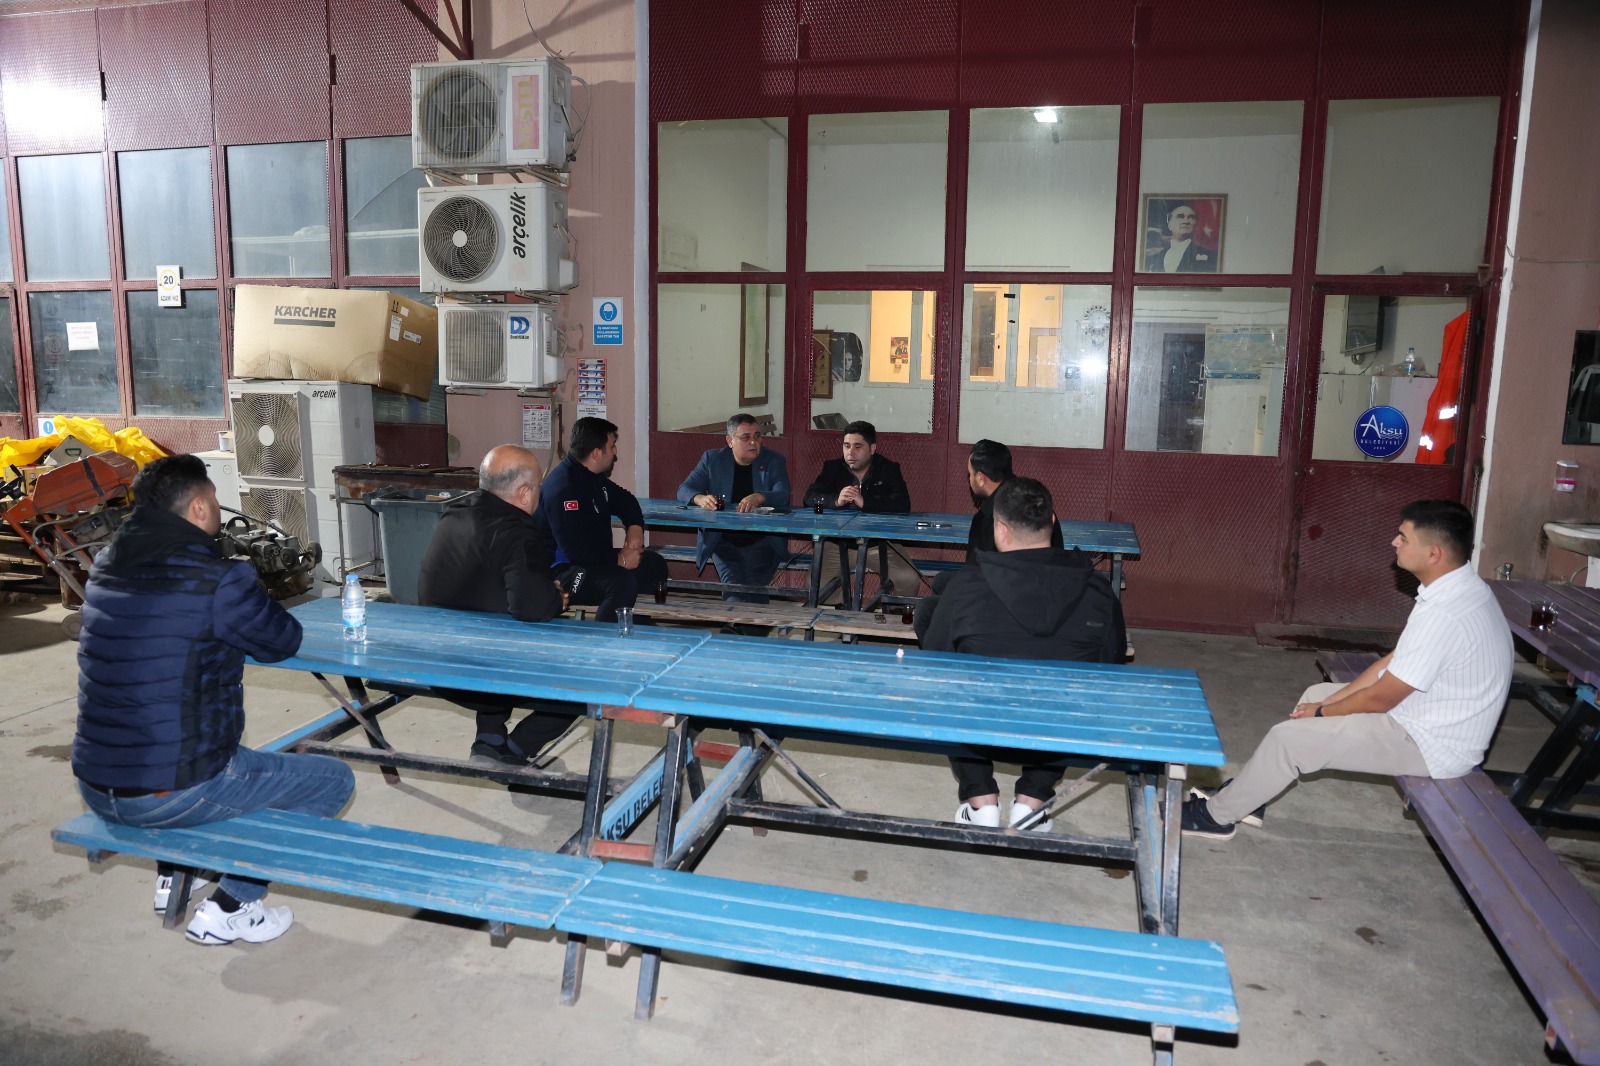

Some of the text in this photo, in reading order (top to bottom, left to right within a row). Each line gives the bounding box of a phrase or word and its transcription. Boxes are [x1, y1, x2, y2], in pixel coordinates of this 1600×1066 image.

[510, 191, 529, 259] arçelik
[163, 275, 174, 285] 20
[274, 305, 337, 319] KÄRCHER
[312, 389, 337, 400] arçelik
[1360, 414, 1403, 439] Aksu
